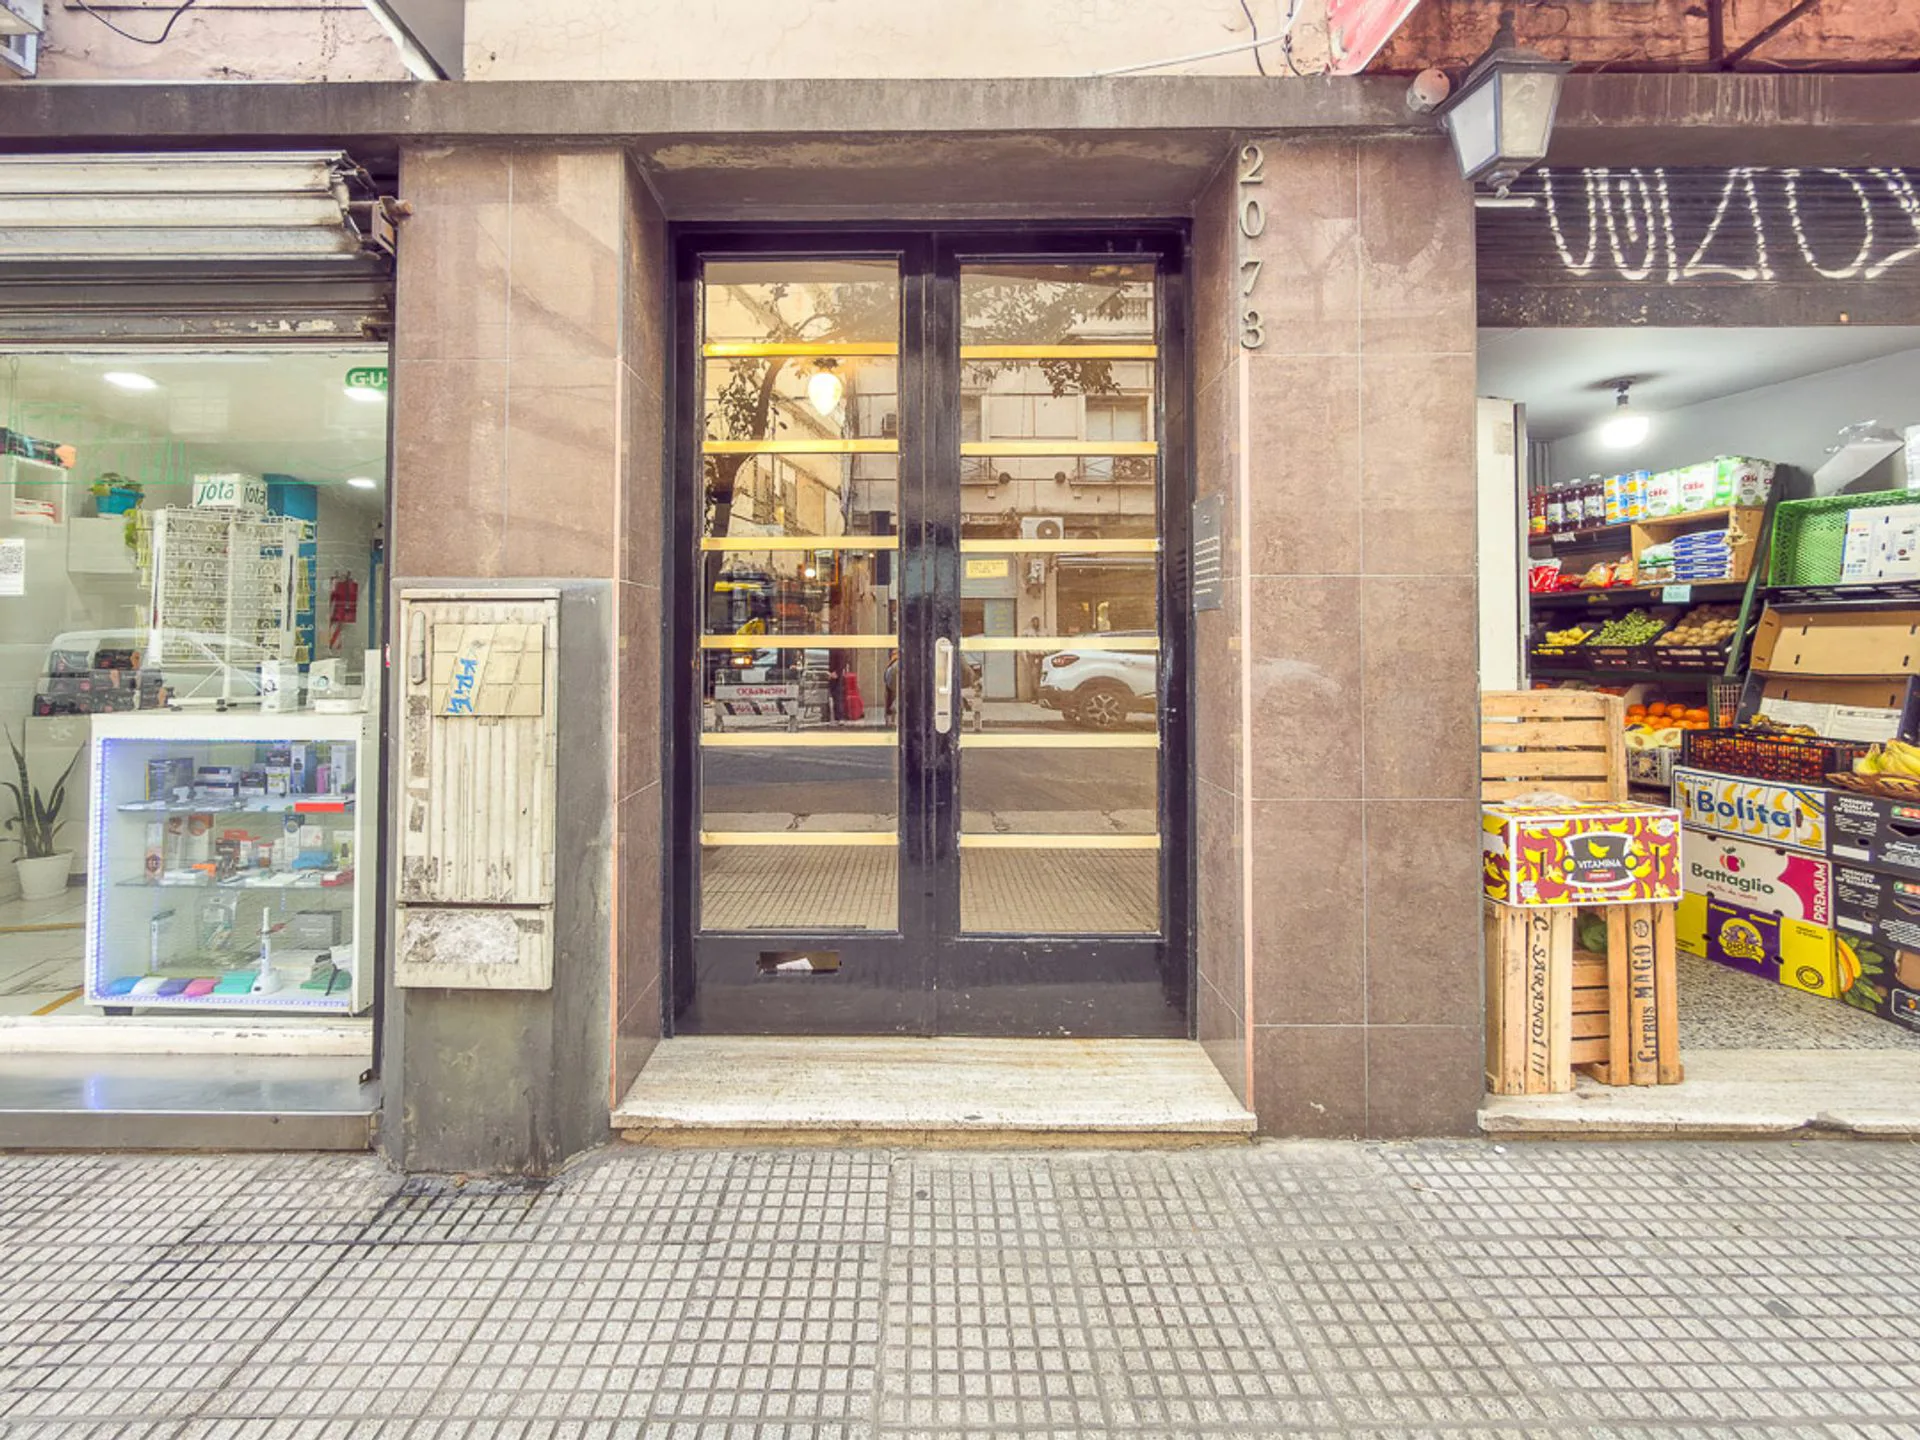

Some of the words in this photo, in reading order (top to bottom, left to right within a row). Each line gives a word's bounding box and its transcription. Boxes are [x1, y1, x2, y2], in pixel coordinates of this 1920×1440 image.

[1240, 144, 1265, 349] 2073
[197, 480, 235, 504] jota
[1697, 790, 1791, 828] Bolita
[1576, 858, 1622, 869] VITAMINA
[1691, 862, 1774, 894] Battaglio
[1813, 861, 1828, 923] PREMIUM
